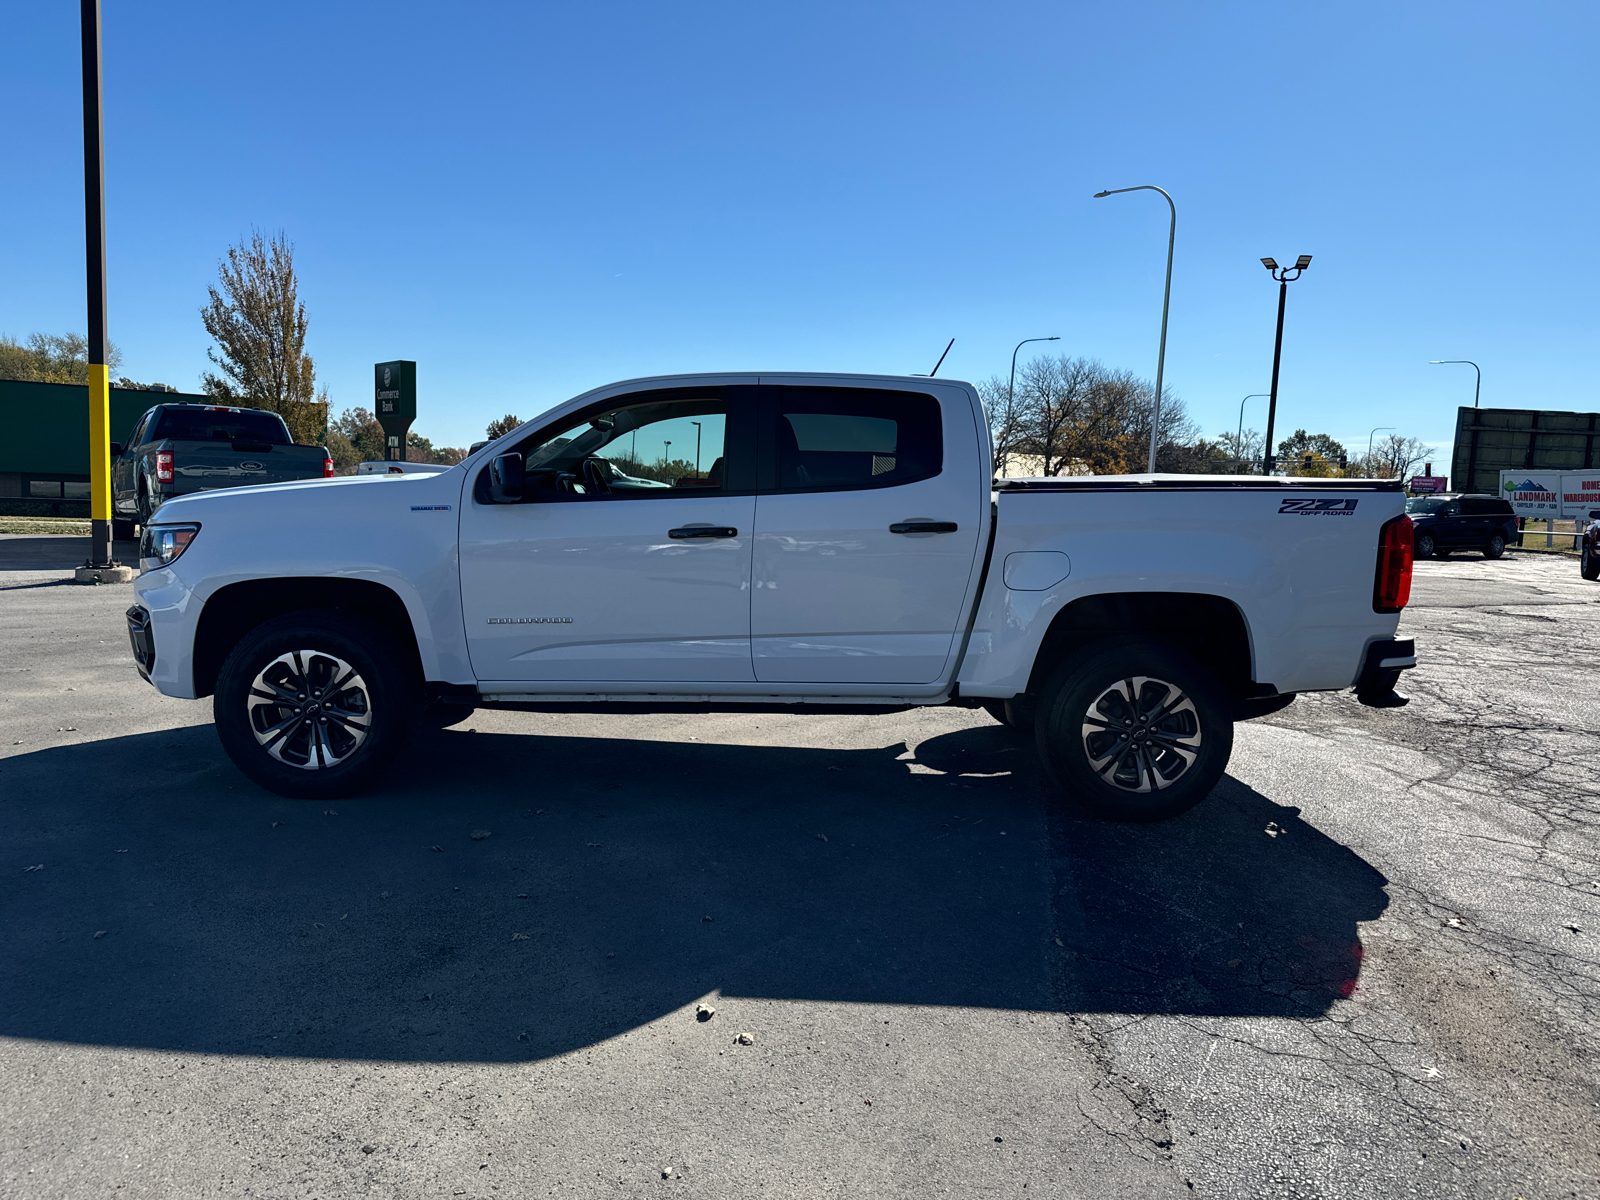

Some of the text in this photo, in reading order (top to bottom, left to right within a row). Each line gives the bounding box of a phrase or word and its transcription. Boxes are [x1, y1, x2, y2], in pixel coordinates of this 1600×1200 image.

[377, 389, 399, 399] Commerce
[382, 401, 393, 412] Bank
[388, 435, 399, 447] ATM
[1582, 481, 1600, 490] HOME
[1514, 492, 1557, 502] LANDMARK
